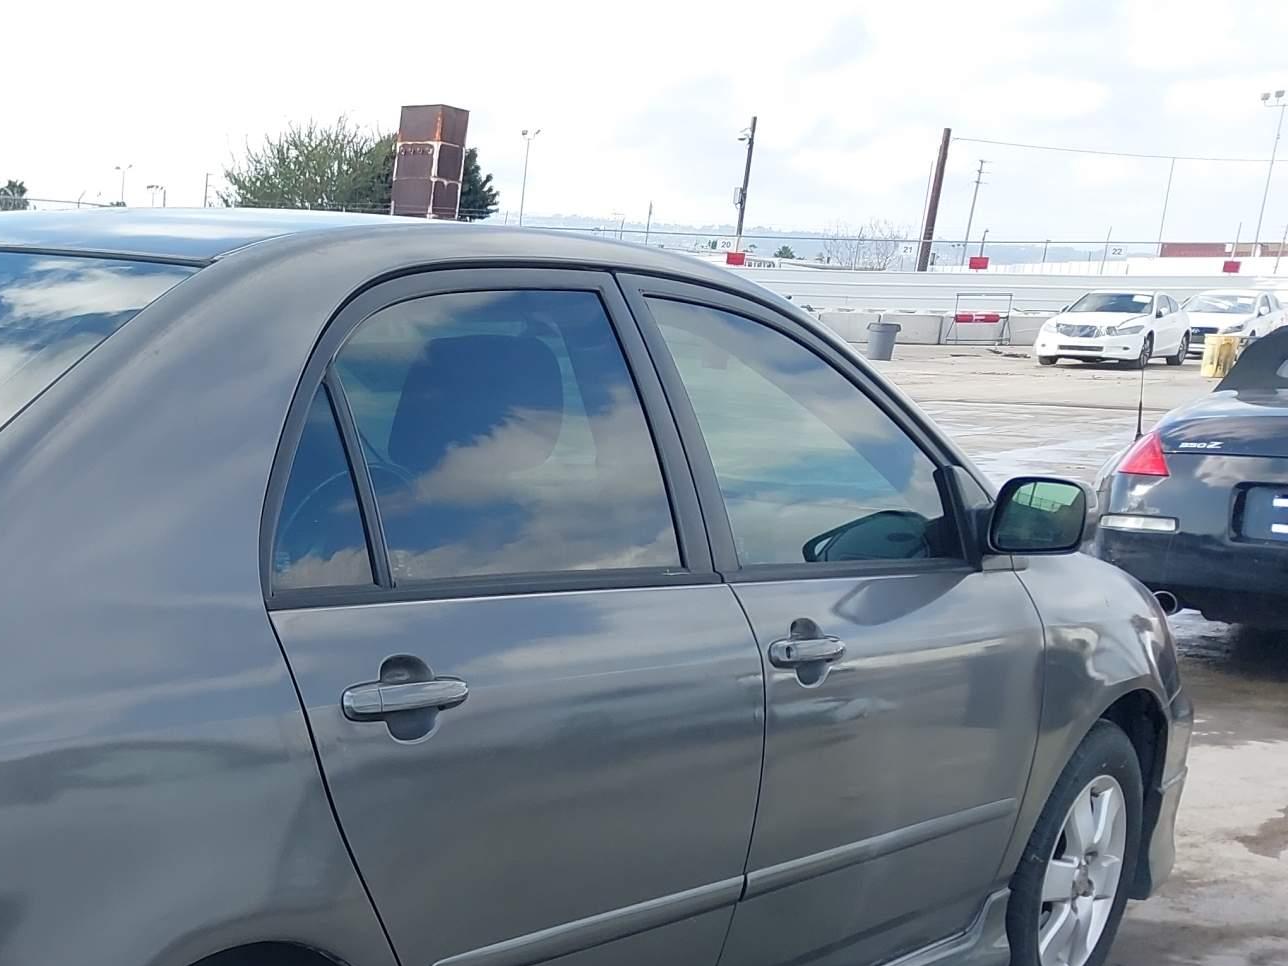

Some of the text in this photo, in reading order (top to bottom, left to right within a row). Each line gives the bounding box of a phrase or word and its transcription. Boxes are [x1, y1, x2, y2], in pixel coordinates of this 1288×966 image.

[720, 241, 732, 249] 20
[903, 246, 913, 254] 21
[1111, 247, 1123, 255] 22
